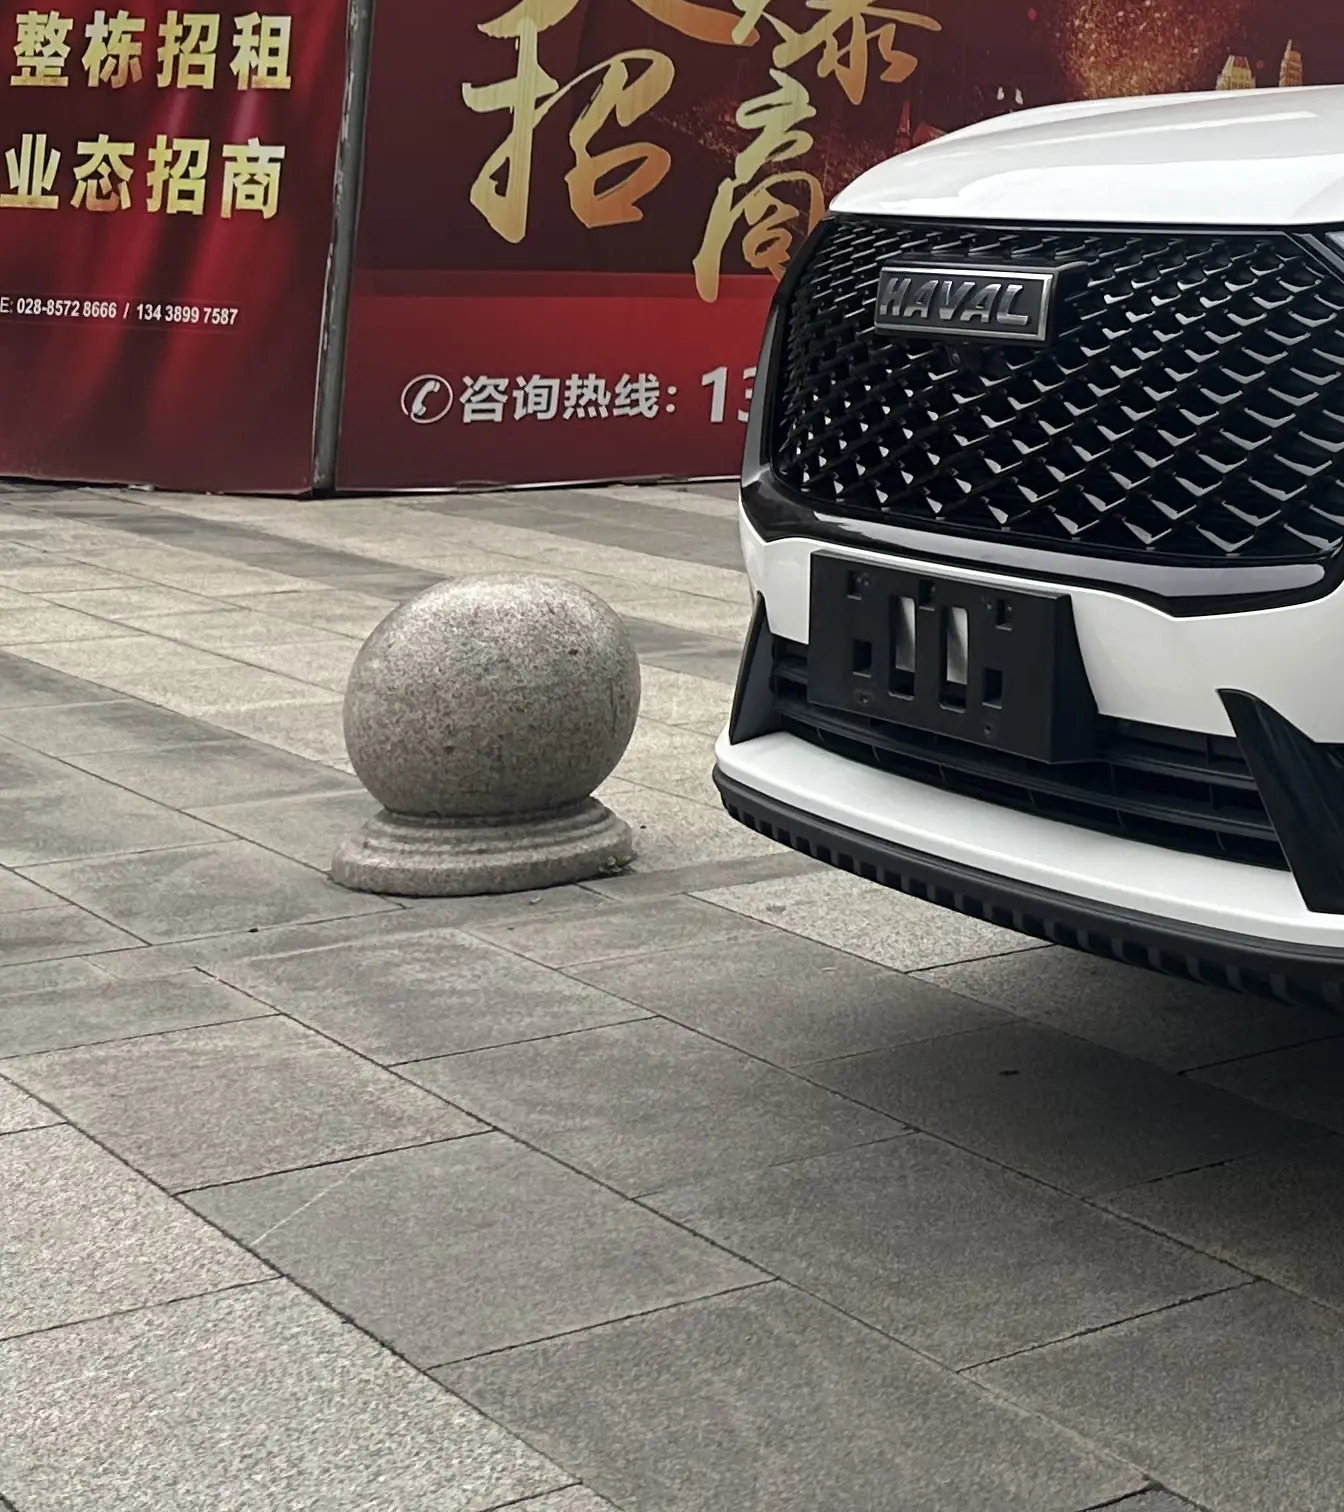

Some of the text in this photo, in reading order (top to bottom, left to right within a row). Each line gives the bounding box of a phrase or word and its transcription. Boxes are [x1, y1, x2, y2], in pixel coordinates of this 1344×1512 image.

[10, 10, 292, 90] 整栋招租
[0, 133, 286, 219] 业态招商
[16, 297, 80, 317] 028-8572
[83, 300, 117, 318] 8666
[136, 303, 162, 321] 134
[165, 304, 200, 323] 3899
[203, 306, 238, 326] 7587
[879, 277, 1029, 326] HAVAL
